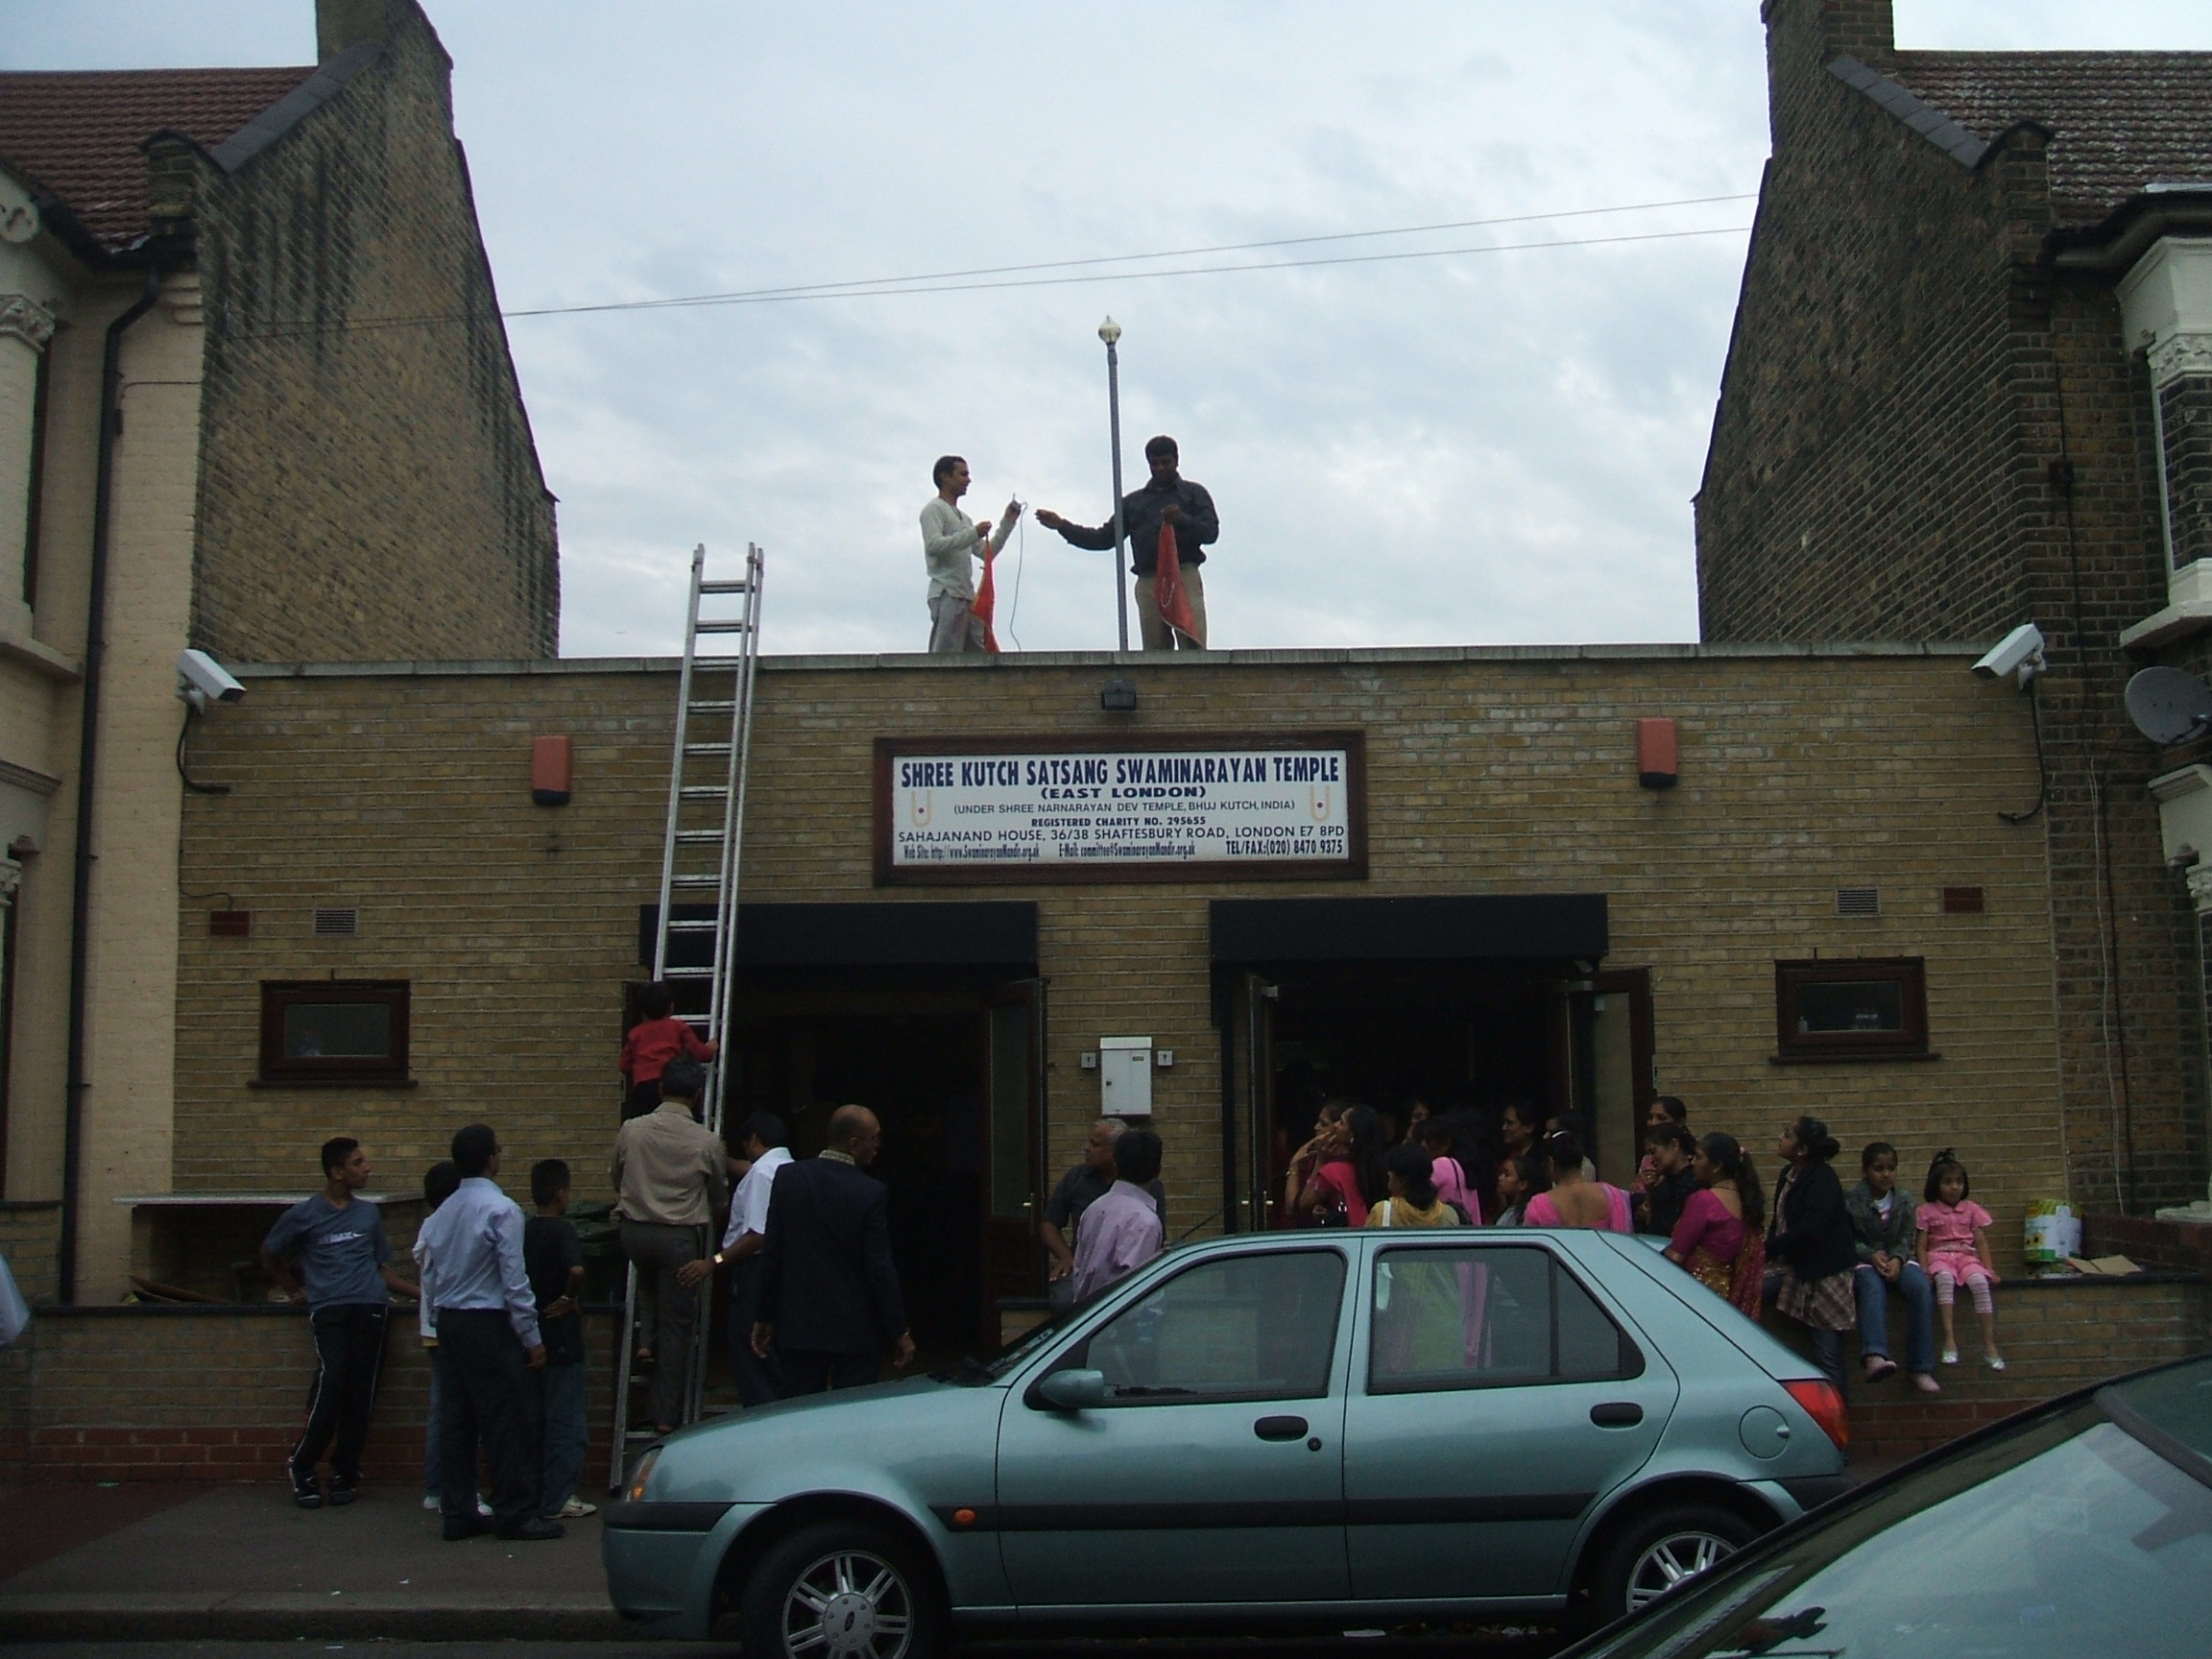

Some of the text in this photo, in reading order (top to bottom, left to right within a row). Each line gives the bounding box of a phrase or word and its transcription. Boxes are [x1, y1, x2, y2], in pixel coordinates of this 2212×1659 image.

[902, 757, 1338, 787] SHREE KUTCH SATSANG SWAMINARAYAN TEMPLE
[1041, 786, 1207, 799] (EAST LONDON)
[953, 805, 995, 814] (UNDER
[998, 804, 1034, 813] SHREE
[1038, 803, 1112, 812] NARNARAYAN
[1118, 803, 1139, 811] DEV
[1031, 816, 1206, 827] REGISTERED CHARITY NO. 295655
[899, 826, 1344, 842] SAHAJANAND HOUSE, 36/38 SHAFTESBURY ROAD, LONDON E7 8PD
[1293, 839, 1316, 854] 8470
[1320, 839, 1343, 854] 9375
